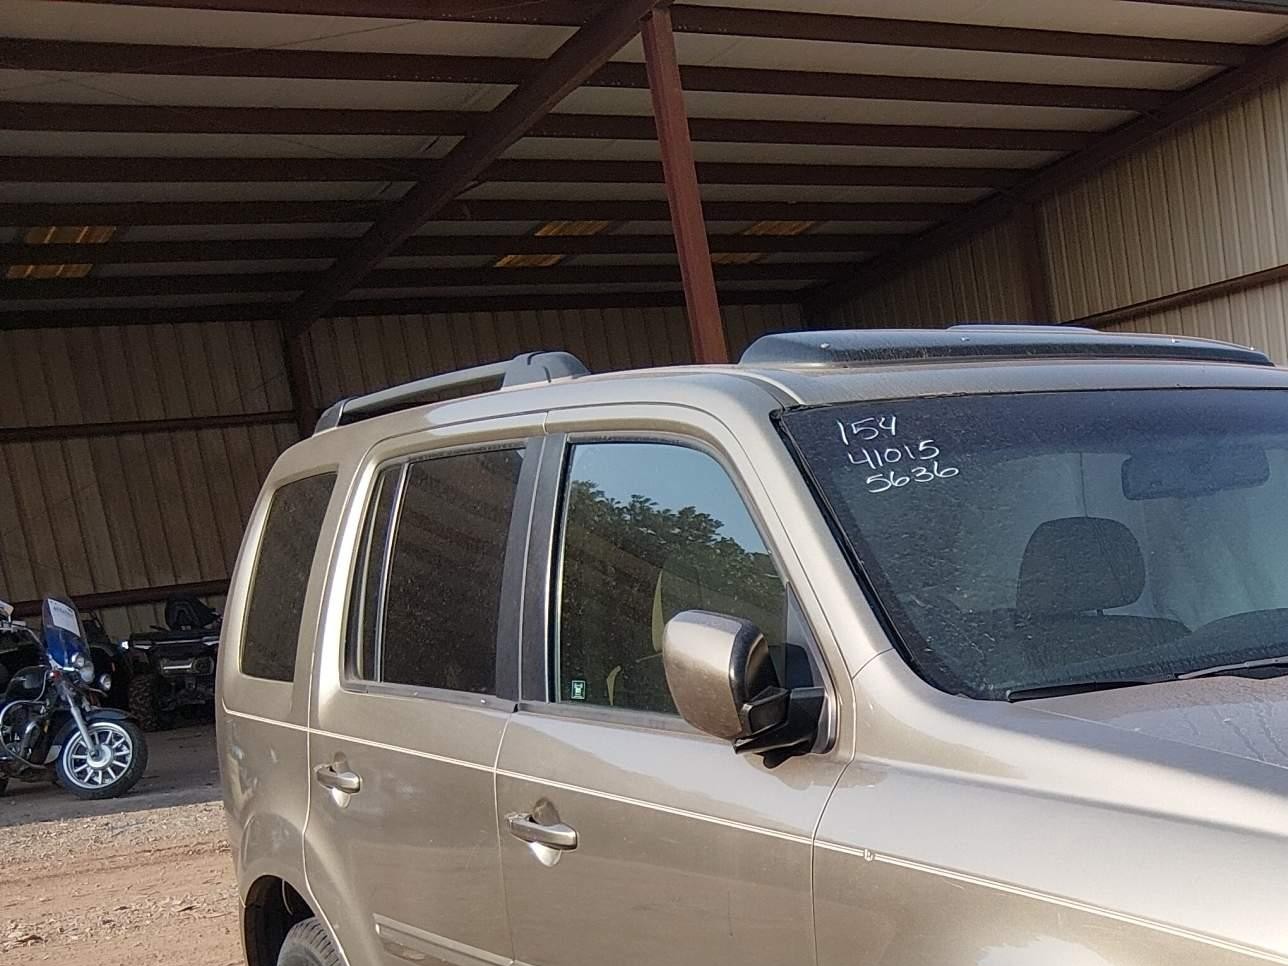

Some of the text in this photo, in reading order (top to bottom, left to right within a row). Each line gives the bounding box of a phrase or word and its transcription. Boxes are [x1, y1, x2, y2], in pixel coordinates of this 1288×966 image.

[837, 415, 896, 445] 154
[847, 439, 940, 470] 41015
[866, 461, 959, 493] 5636
